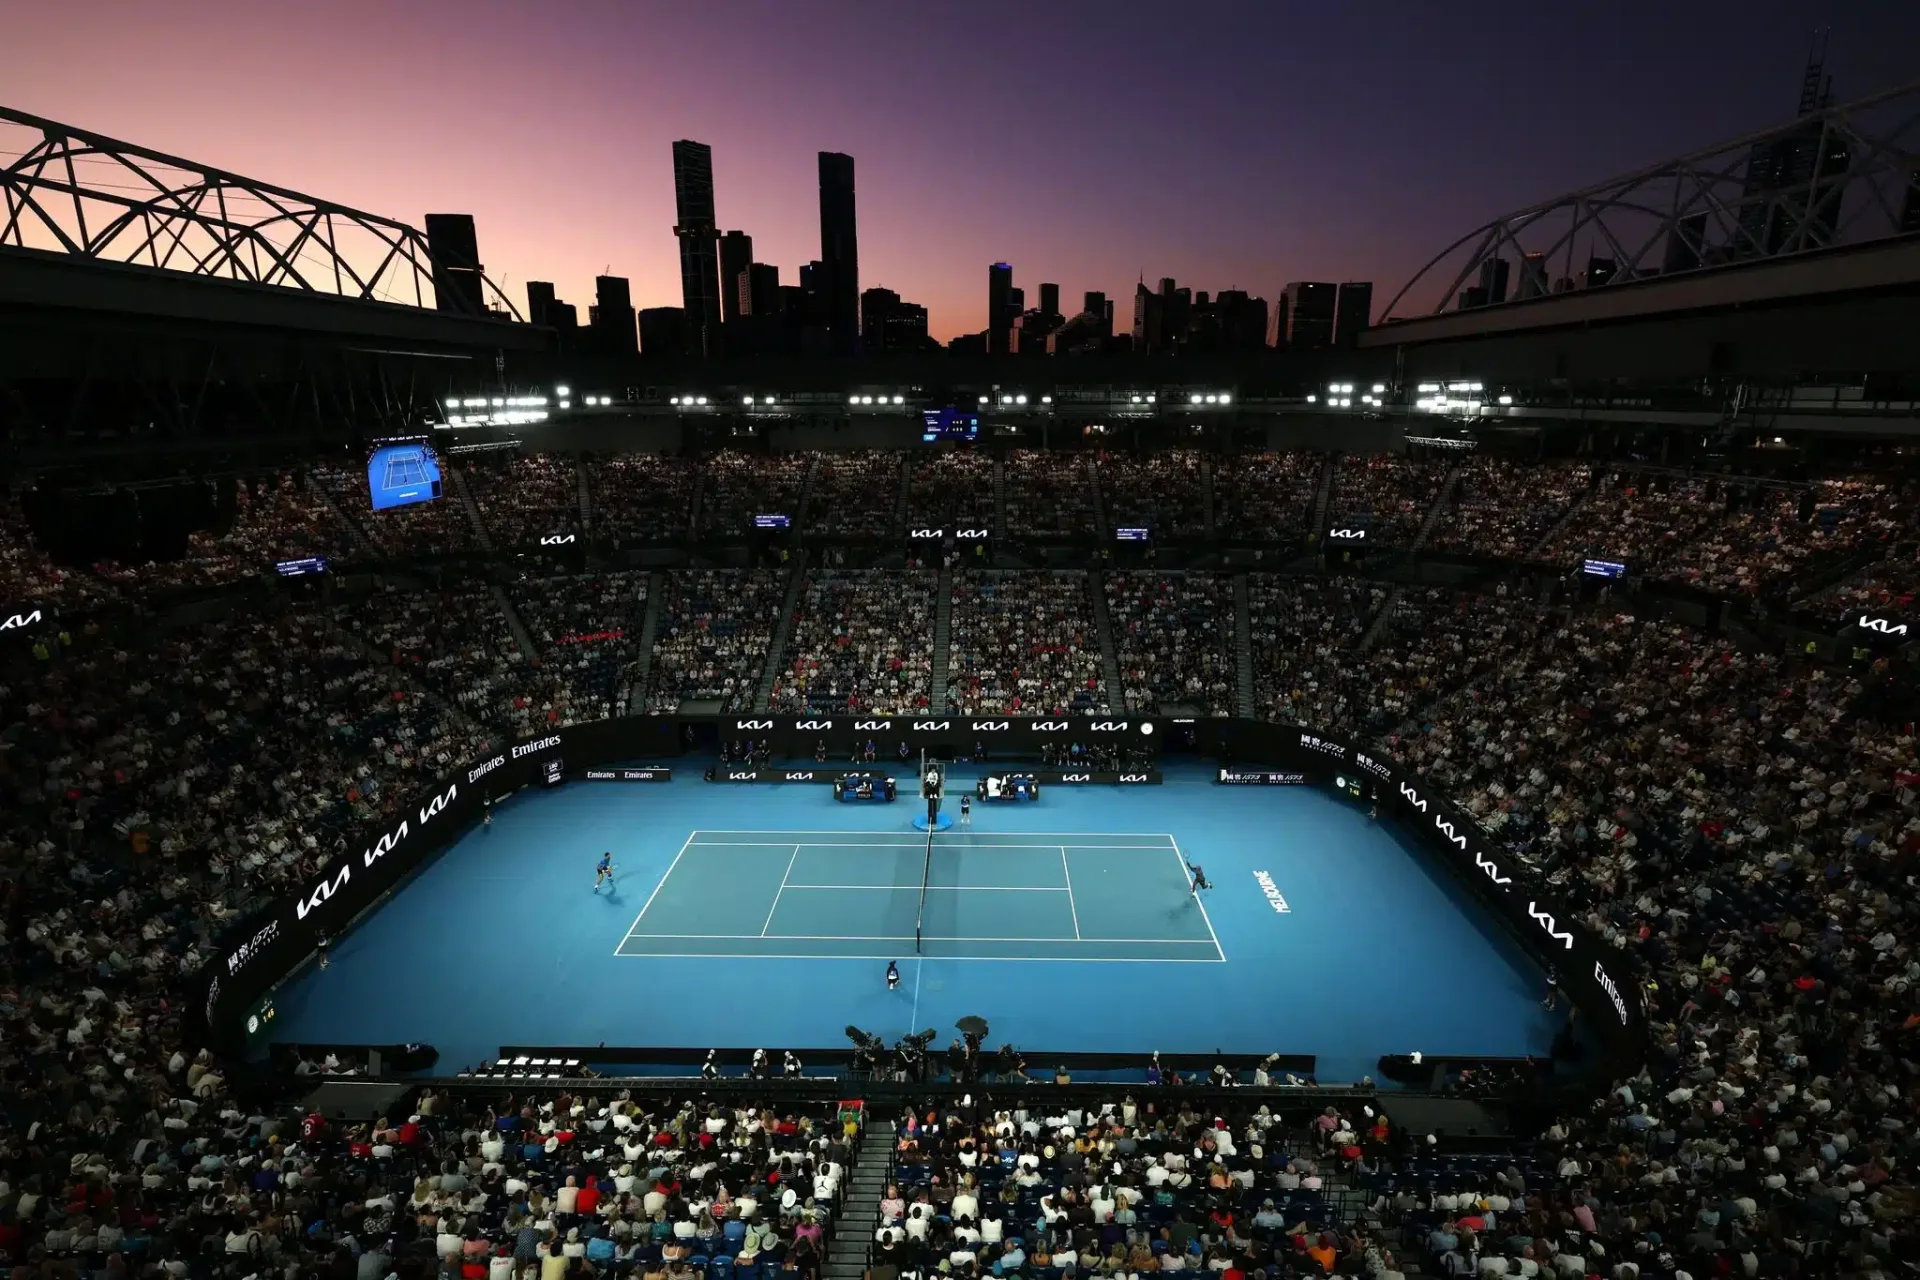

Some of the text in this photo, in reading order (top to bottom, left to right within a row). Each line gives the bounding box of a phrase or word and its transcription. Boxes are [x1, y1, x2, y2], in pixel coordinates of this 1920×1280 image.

[540, 534, 576, 546] KIA
[911, 529, 988, 538] KIA KIA
[1329, 528, 1365, 539] KIA
[1858, 615, 1908, 636] KIA
[736, 720, 1128, 731] KIA KIA KIA KIA KIA KIA KIA
[511, 734, 561, 760] Emirates
[468, 754, 505, 784] Emirates
[587, 771, 653, 779] Emirates Emirates
[729, 772, 813, 780] KIA KIA
[1062, 773, 1147, 782] KIA KIA
[419, 784, 457, 825] KIA
[1400, 781, 1428, 813] KIA
[363, 820, 409, 868] KIA
[1435, 814, 1467, 850] KIA
[1475, 851, 1512, 893] KIA
[296, 864, 351, 920] KIA
[1528, 901, 1574, 950] KIA
[1593, 959, 1628, 1026] Emirates
[305, 1123, 311, 1136] 8
